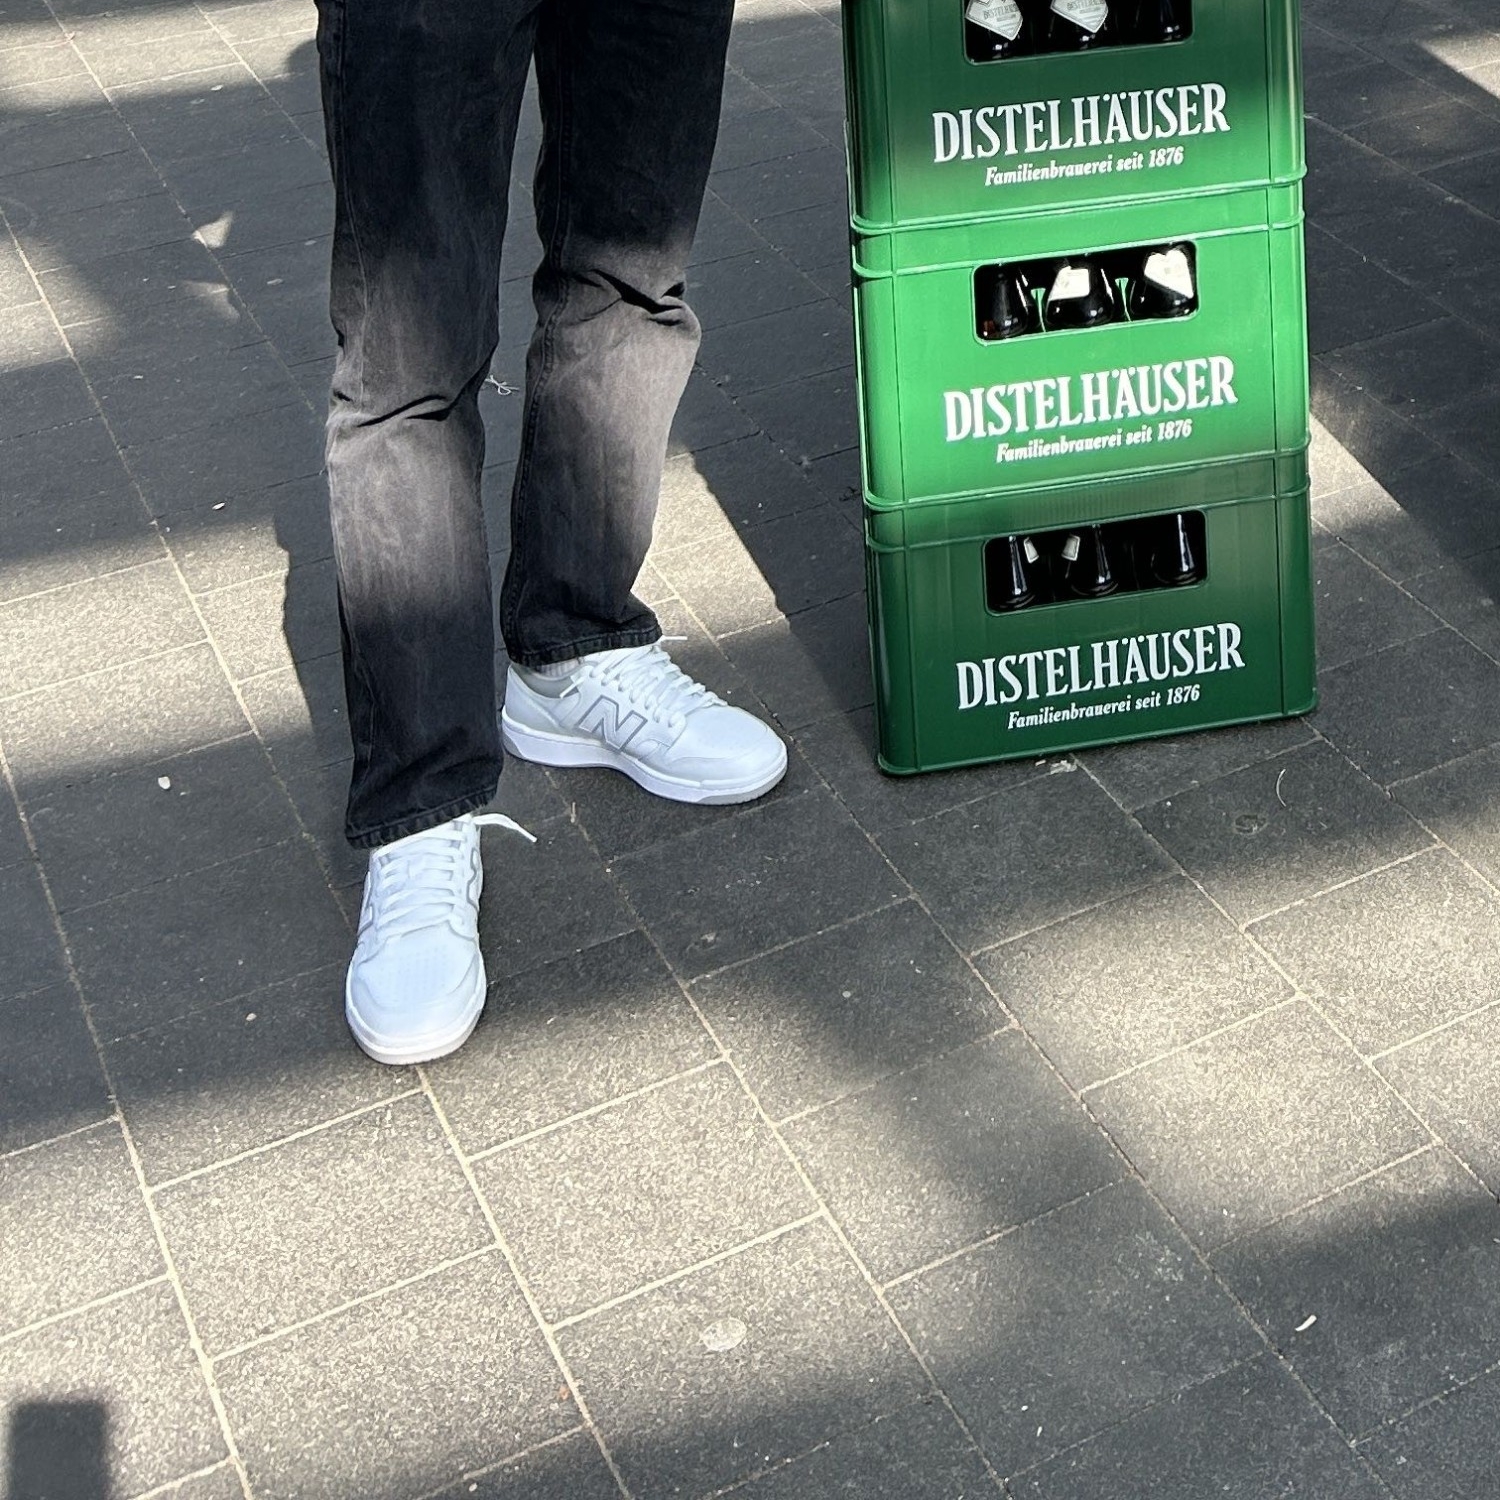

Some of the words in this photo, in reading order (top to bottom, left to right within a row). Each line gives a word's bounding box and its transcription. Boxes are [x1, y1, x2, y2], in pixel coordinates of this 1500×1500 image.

[933, 84, 1230, 163] DISTELHÄUSER
[985, 155, 1113, 186] Familienbrauerei
[1116, 152, 1144, 172] seit
[1148, 146, 1184, 169] 1876
[944, 356, 1238, 441] DISTELHÄUSER
[997, 428, 1122, 463] Familienbrauerei
[1126, 425, 1152, 445] seit
[1157, 419, 1193, 440] 1876
[956, 623, 1245, 710] DISTELHÄUSER
[574, 694, 648, 755] N
[1007, 696, 1131, 730] Familienbrauerei
[1135, 692, 1161, 711] seit
[1166, 684, 1200, 706] 1876
